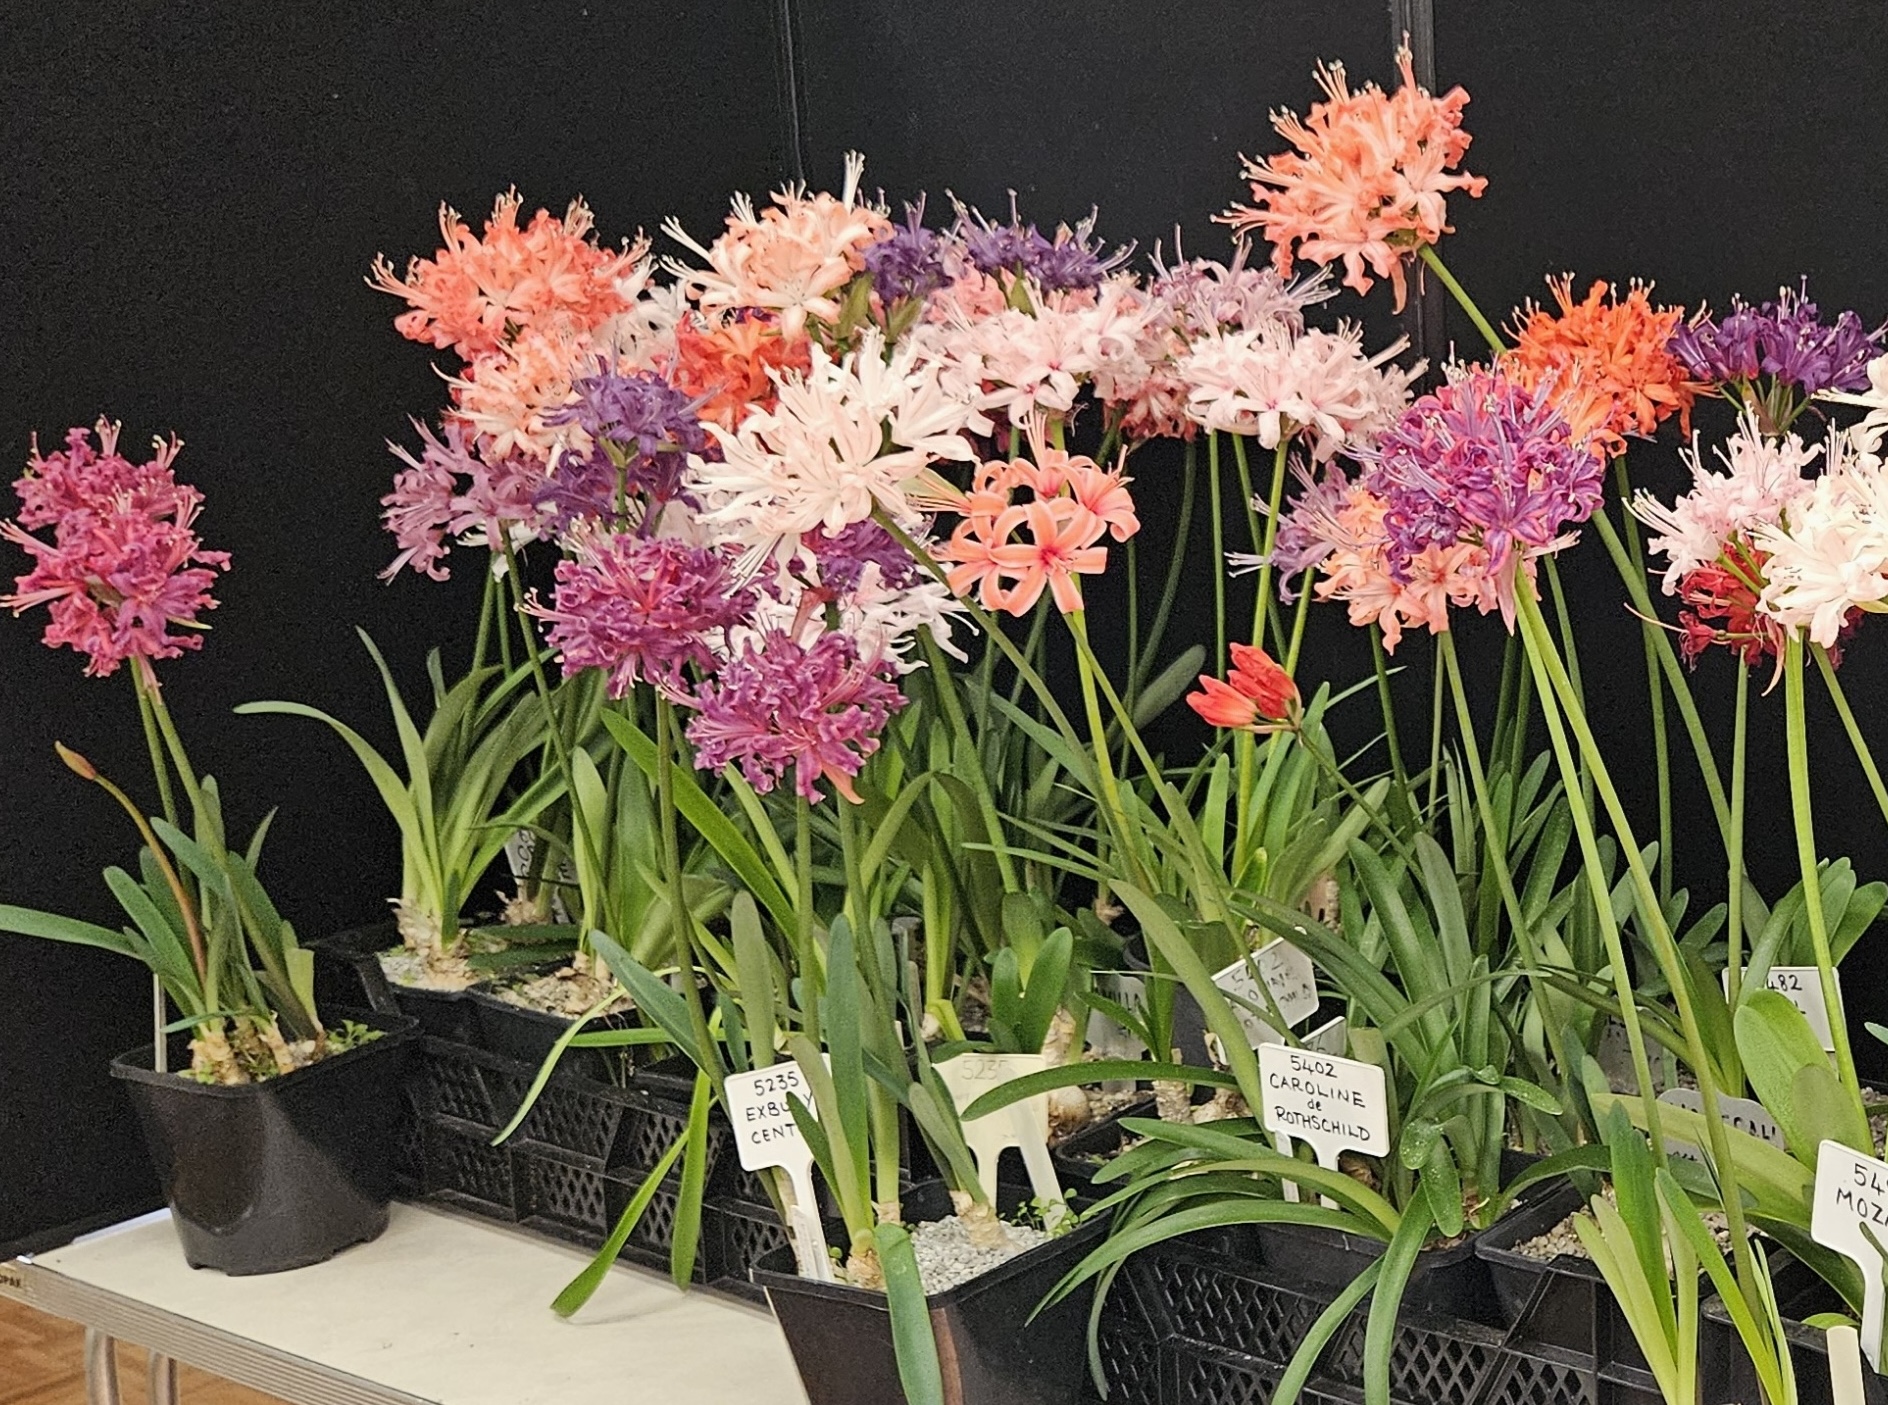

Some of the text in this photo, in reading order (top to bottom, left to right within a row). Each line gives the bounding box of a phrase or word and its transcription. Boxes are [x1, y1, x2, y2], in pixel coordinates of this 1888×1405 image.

[1290, 1055, 1338, 1079] 5402
[754, 1071, 799, 1096] 5235
[1269, 1073, 1366, 1108] CAROLINE
[745, 1092, 813, 1122] EXBUY
[1307, 1098, 1322, 1112] de
[1274, 1105, 1371, 1141] ROTHSCHILD
